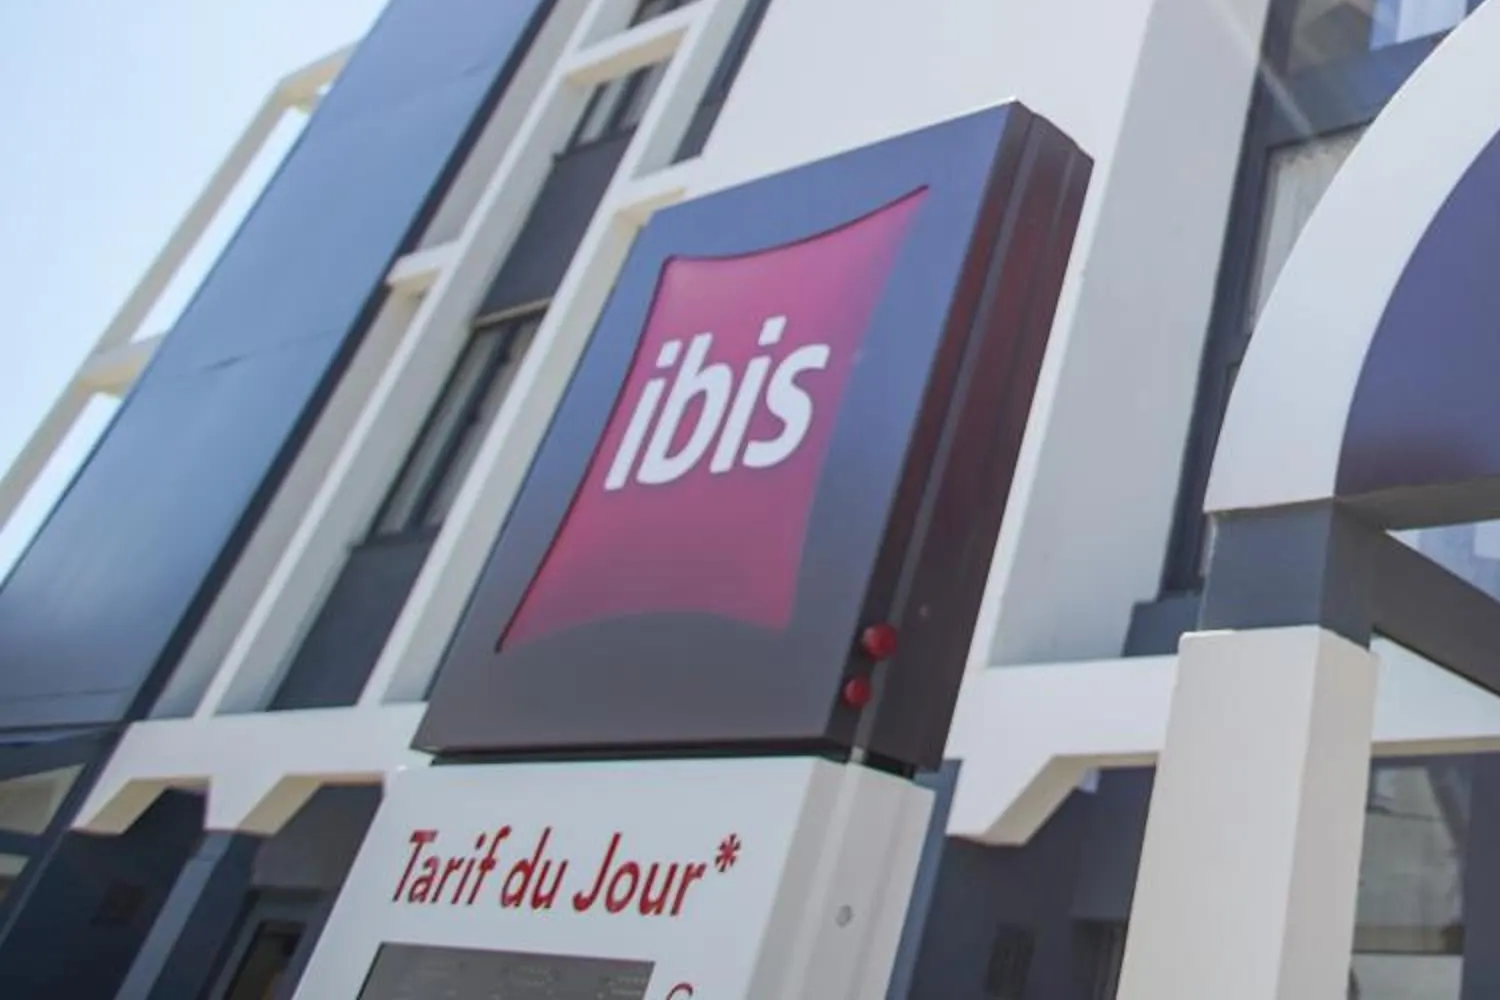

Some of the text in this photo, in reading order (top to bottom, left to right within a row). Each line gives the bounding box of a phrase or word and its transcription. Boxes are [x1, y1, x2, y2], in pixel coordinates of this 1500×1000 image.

[604, 315, 831, 491] ibis
[392, 825, 511, 904] Tarif
[501, 826, 569, 909] du
